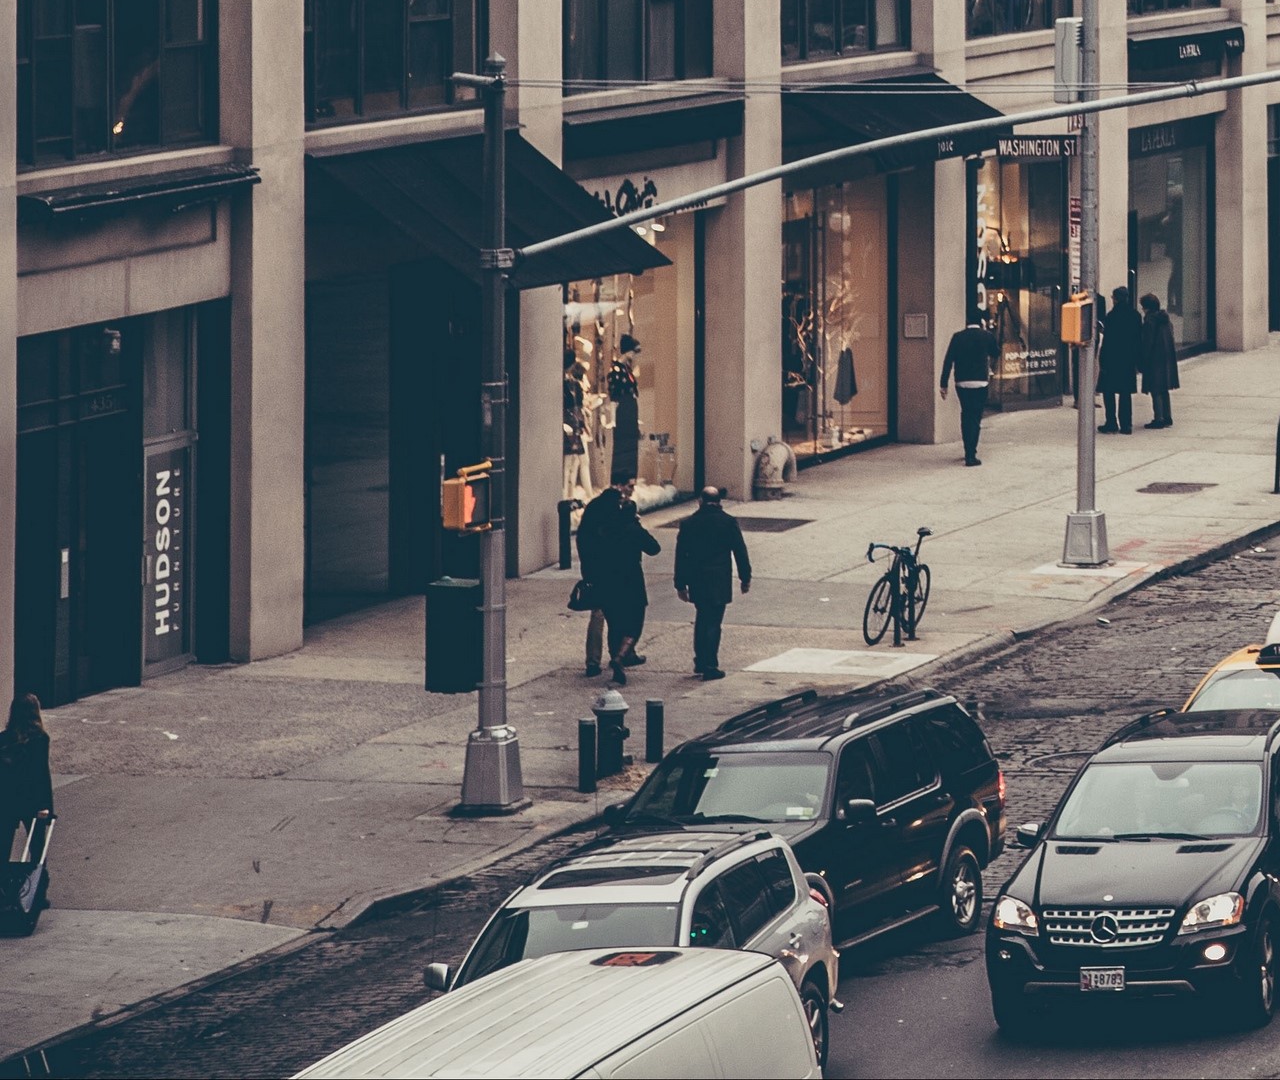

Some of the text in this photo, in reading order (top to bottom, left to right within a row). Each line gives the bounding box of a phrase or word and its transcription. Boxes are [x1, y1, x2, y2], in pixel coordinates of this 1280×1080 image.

[999, 138, 1075, 156] WASHINGTON ST
[155, 470, 171, 636] HUDSON
[173, 467, 181, 632] FURNITURE
